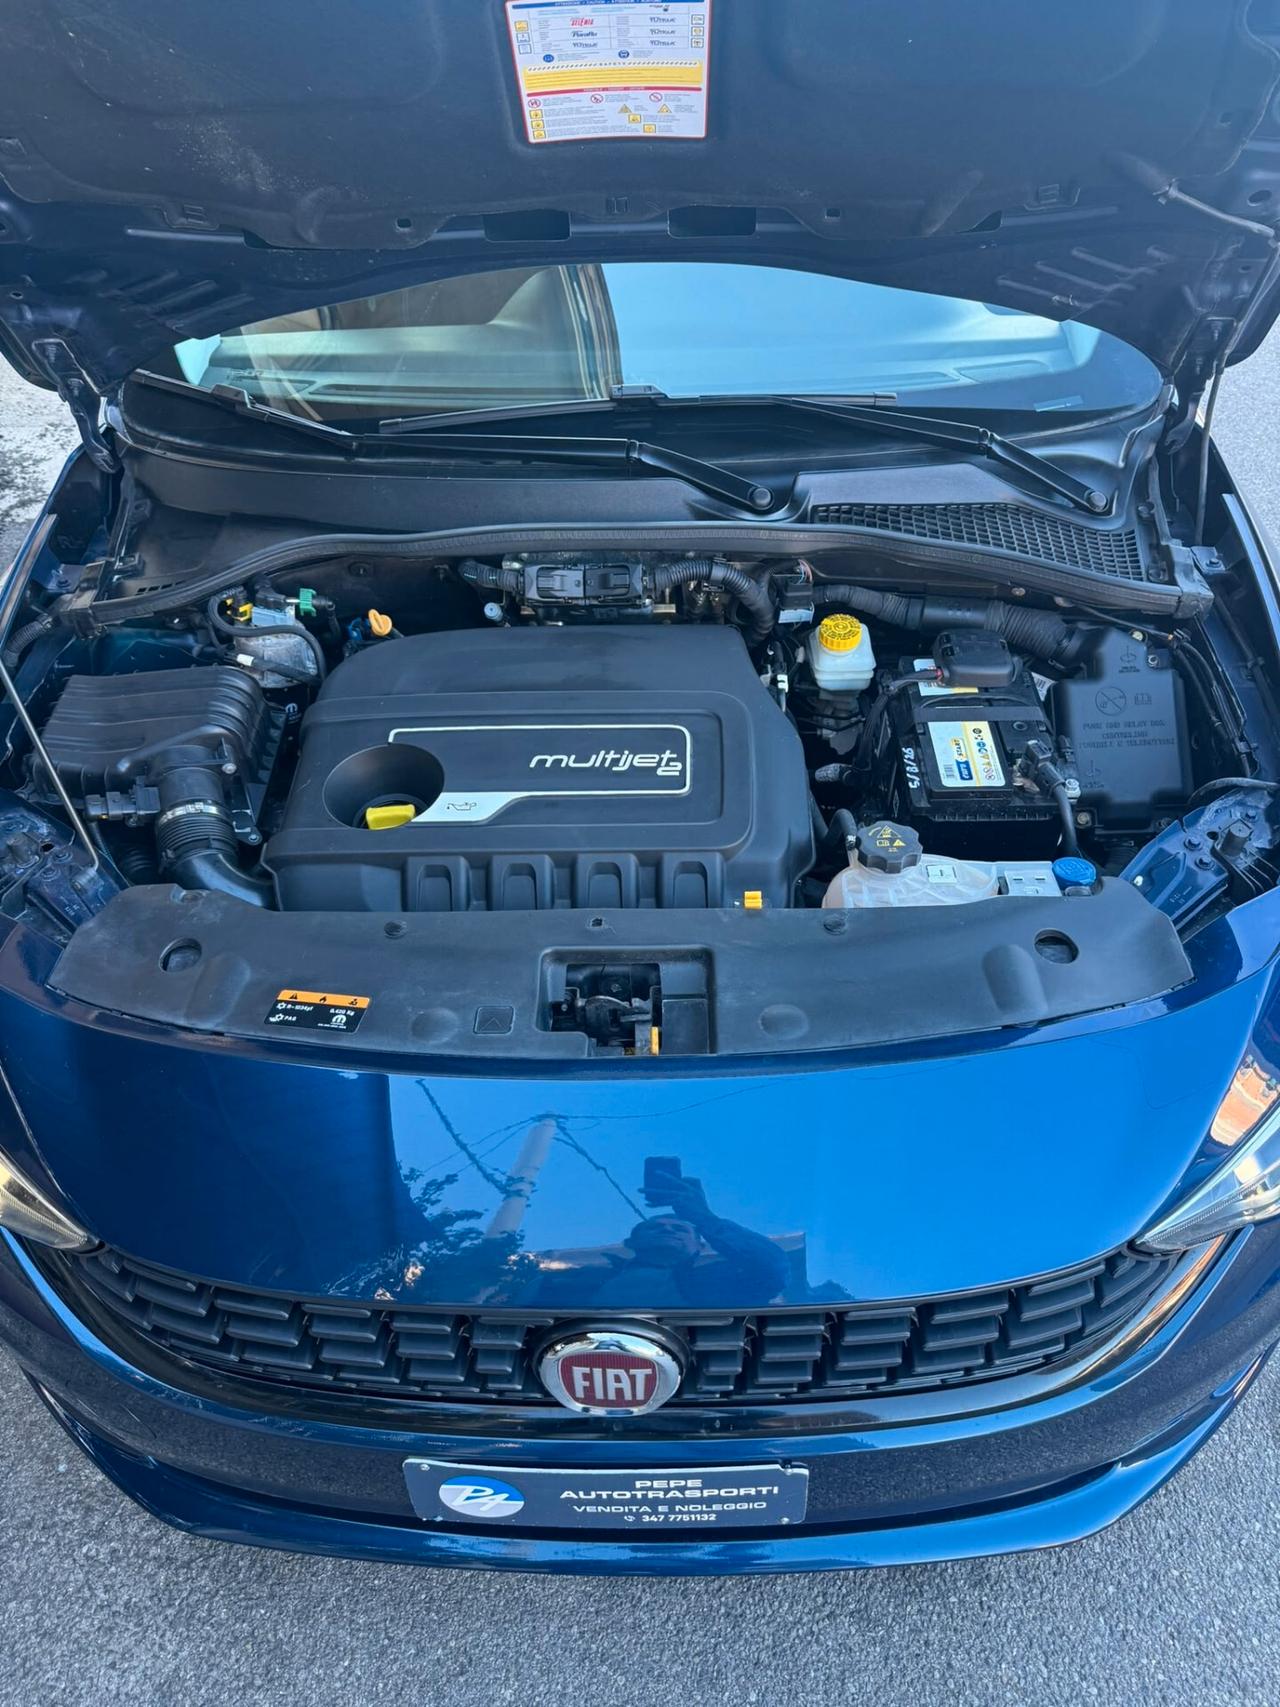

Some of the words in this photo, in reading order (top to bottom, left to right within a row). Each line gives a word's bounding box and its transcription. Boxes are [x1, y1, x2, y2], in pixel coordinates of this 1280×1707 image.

[571, 1366, 653, 1401] FIAT
[634, 1479, 703, 1489] PEPE
[559, 1486, 779, 1499] AUTOTRASPORTI
[572, 1505, 652, 1513] VENDITA
[674, 1501, 768, 1512] NOLEGGIO
[641, 1514, 665, 1522] 347
[668, 1513, 717, 1522] 7751132
